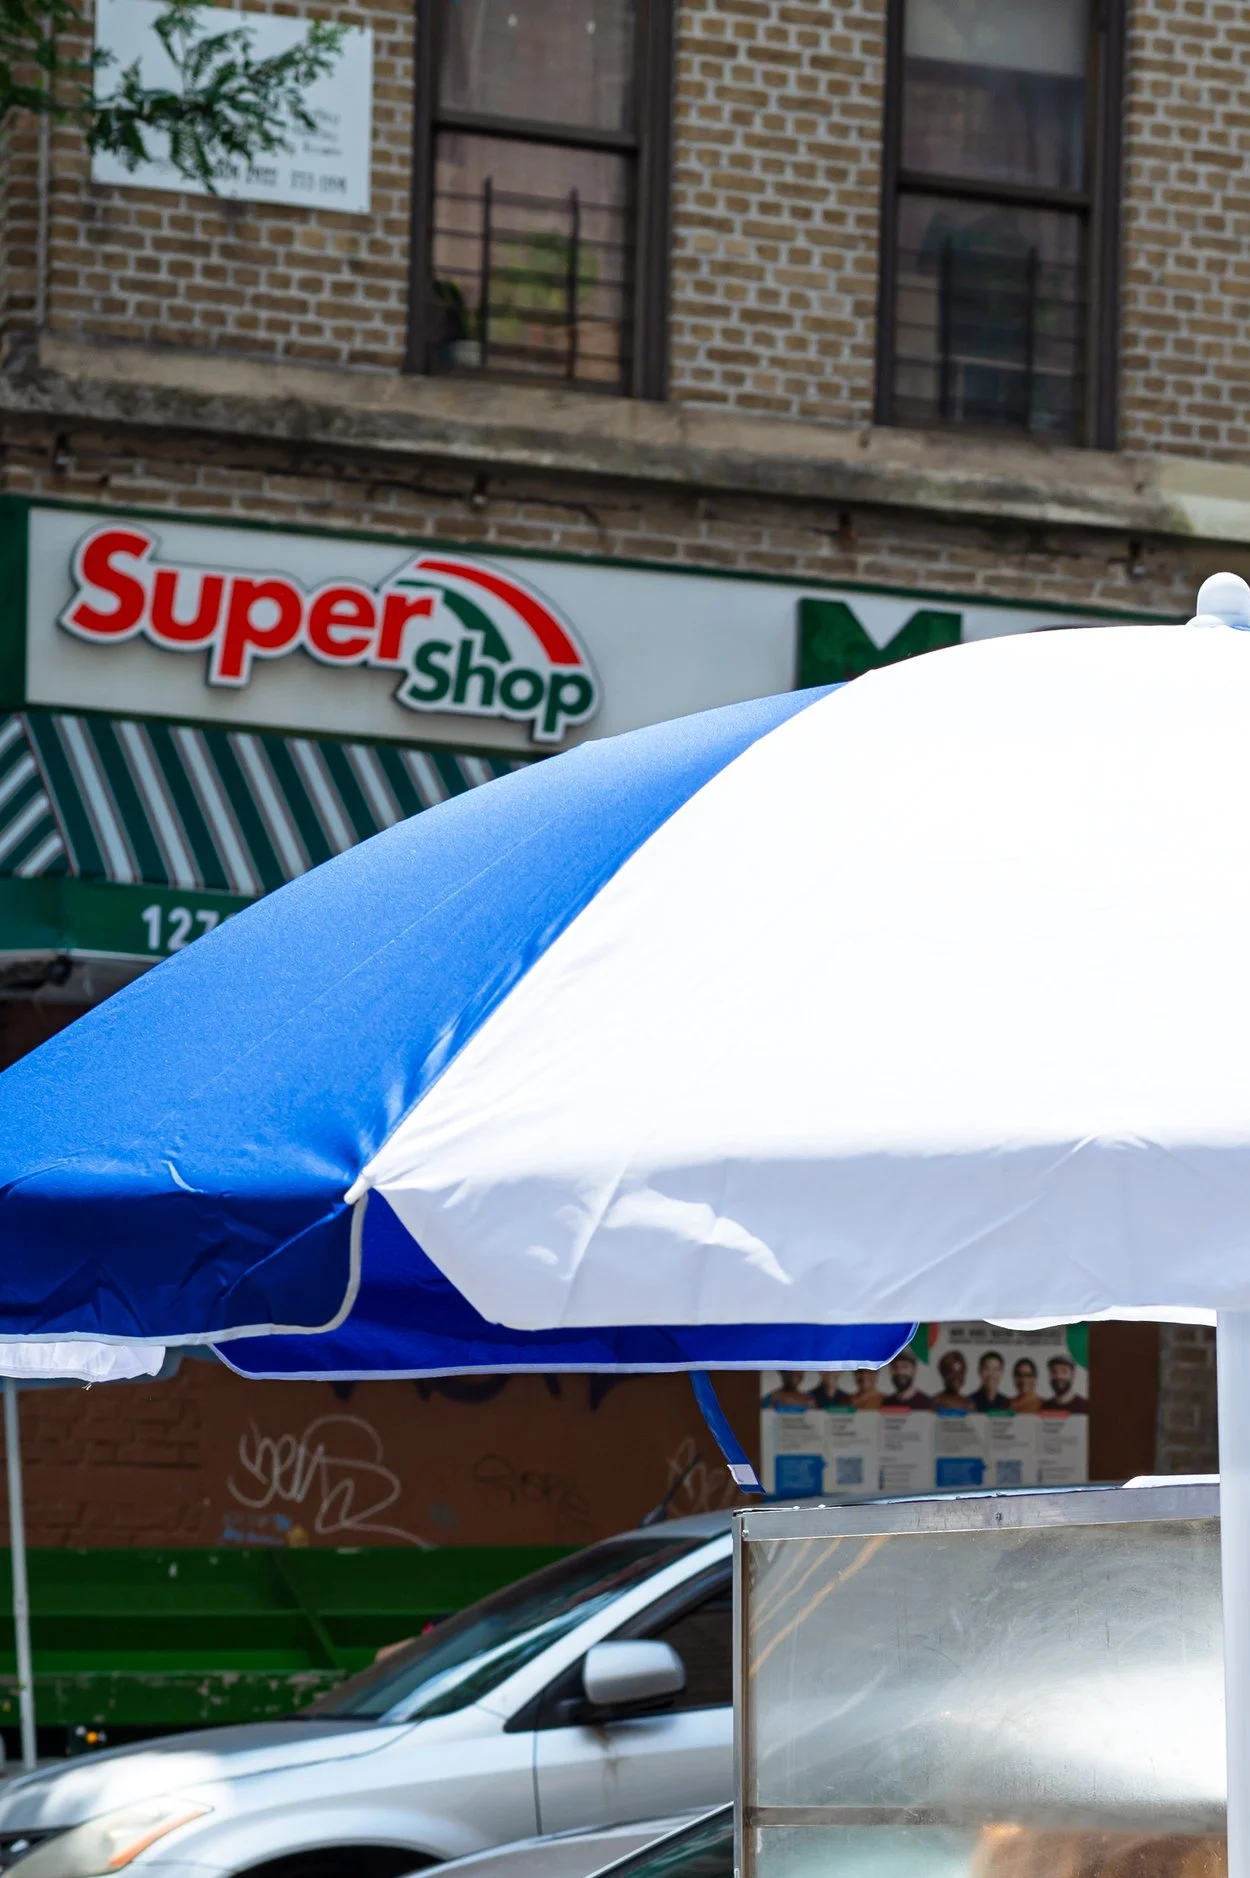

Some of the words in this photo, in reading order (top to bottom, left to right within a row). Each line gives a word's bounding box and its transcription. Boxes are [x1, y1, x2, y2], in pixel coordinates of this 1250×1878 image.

[71, 529, 434, 678] Super
[408, 631, 595, 734] Shop
[141, 904, 238, 952] 127
